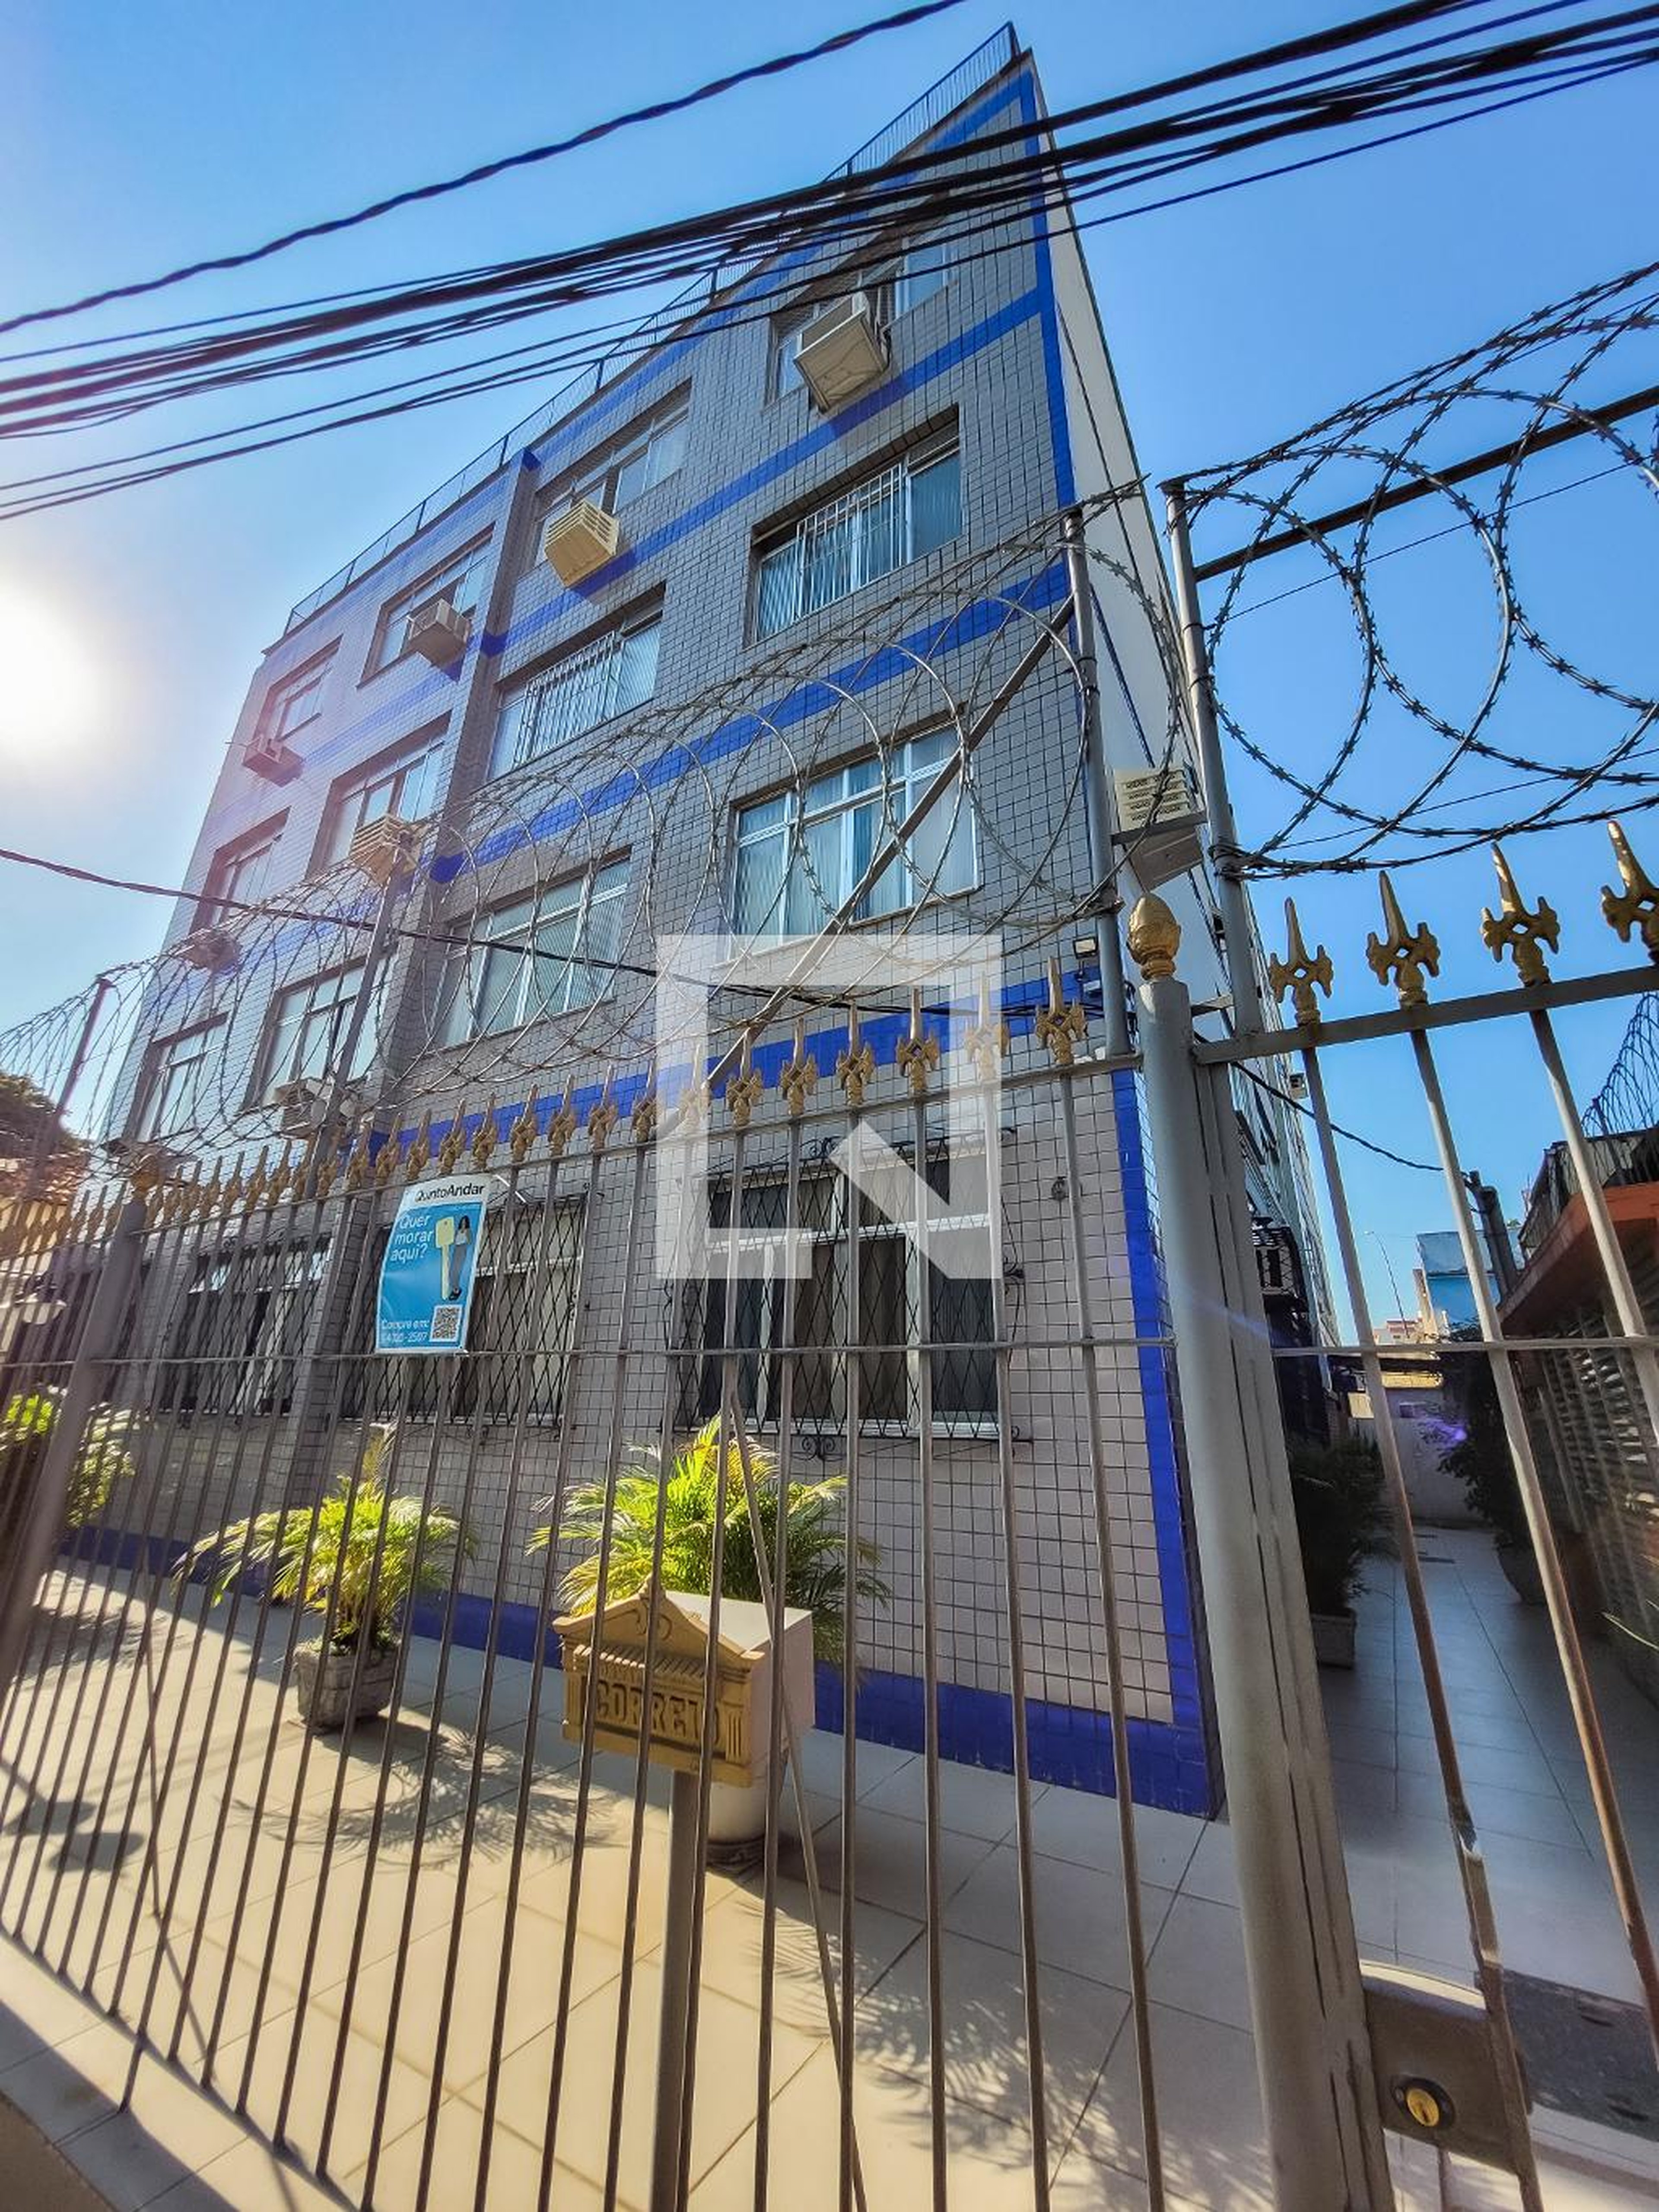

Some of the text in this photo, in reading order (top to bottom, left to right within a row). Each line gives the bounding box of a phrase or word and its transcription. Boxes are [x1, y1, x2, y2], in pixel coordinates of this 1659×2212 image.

[400, 1215, 431, 1229] Quer
[395, 1231, 433, 1244] morar
[390, 1243, 428, 1264] aqui?
